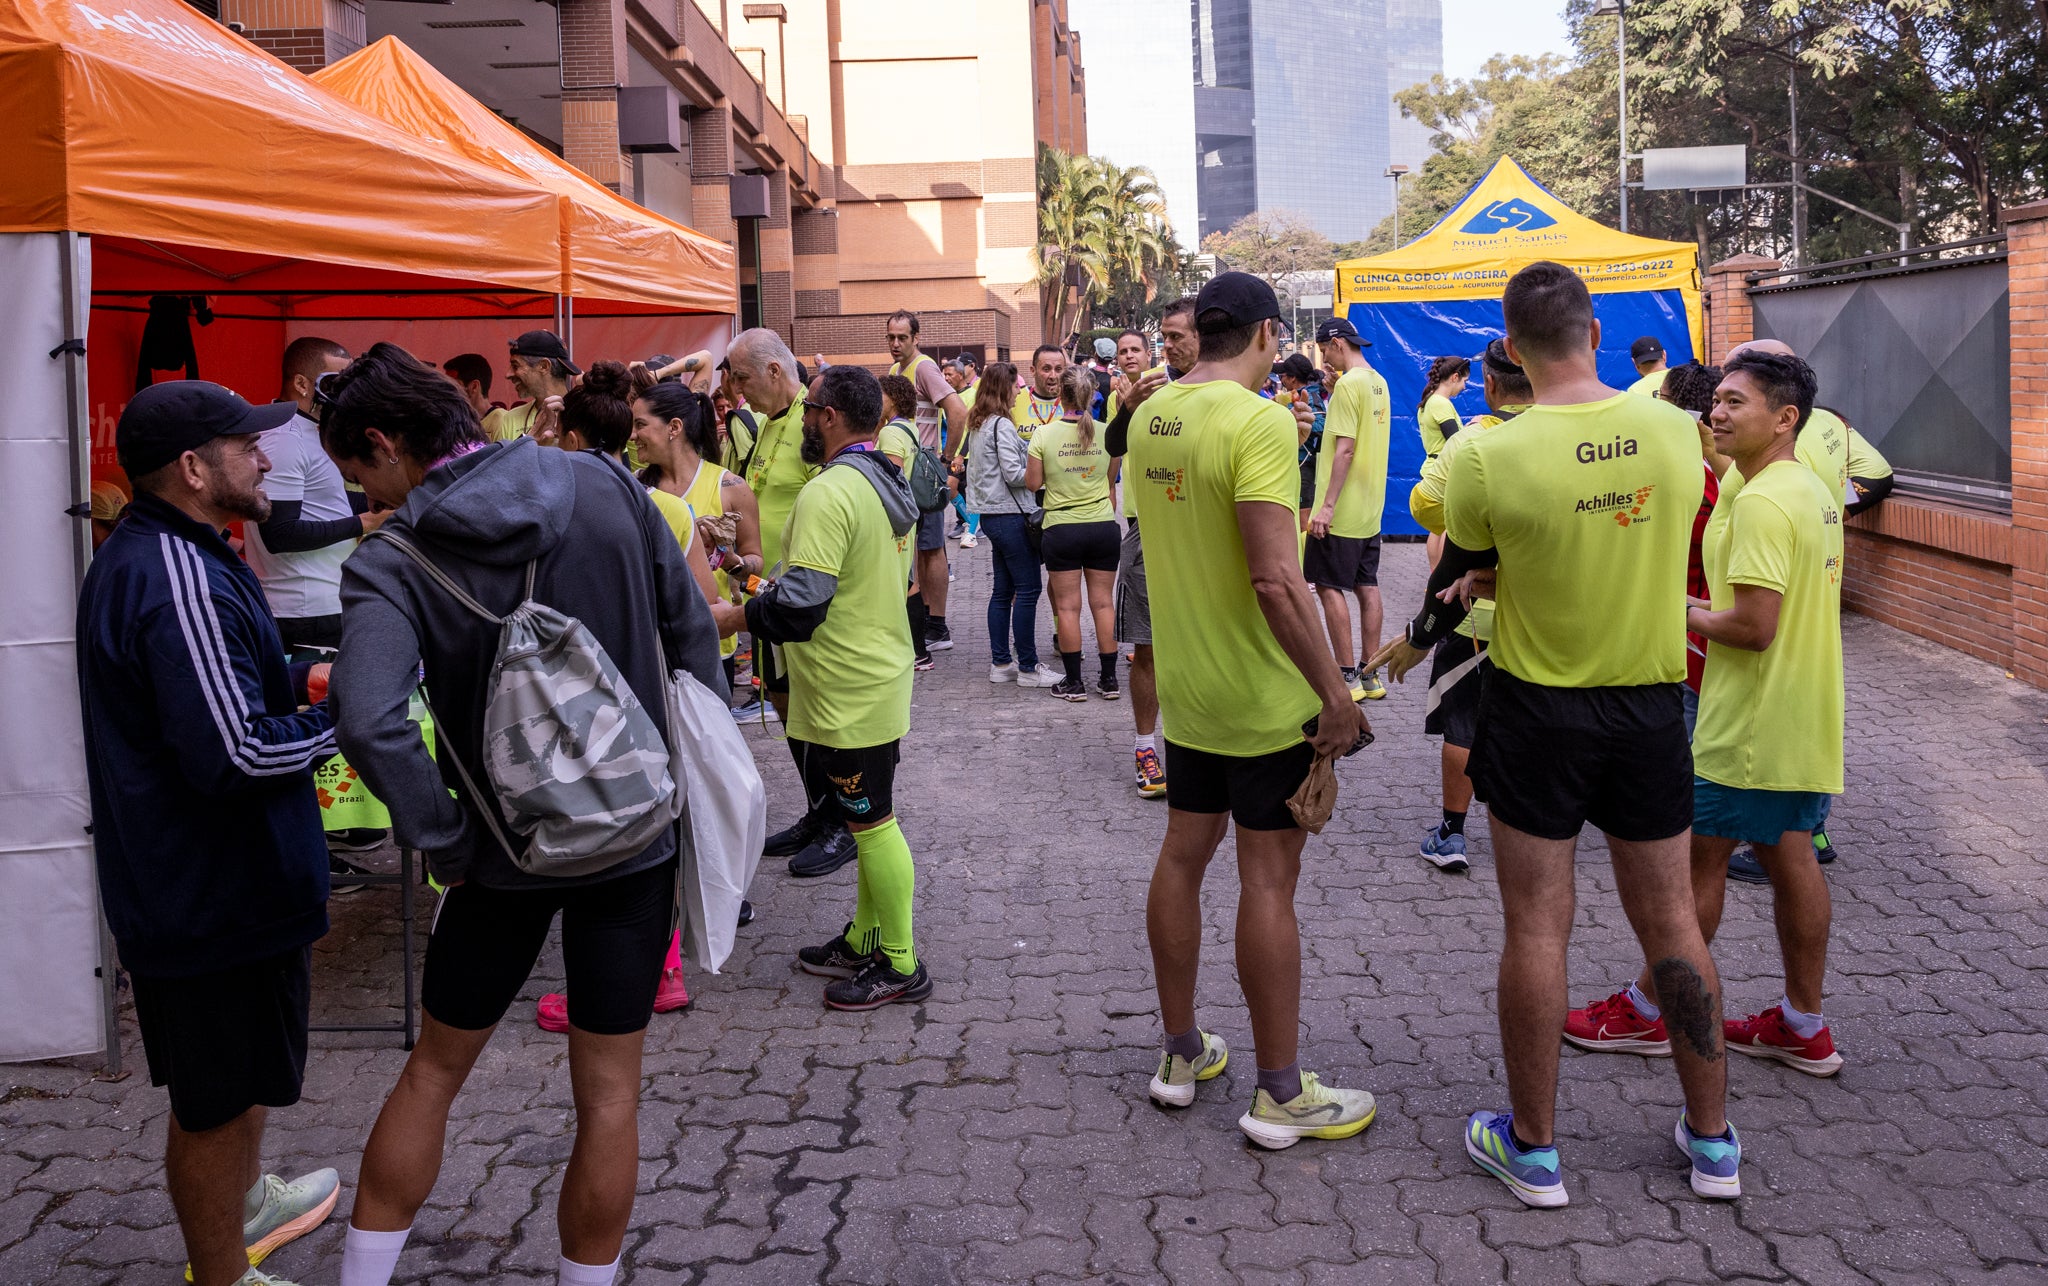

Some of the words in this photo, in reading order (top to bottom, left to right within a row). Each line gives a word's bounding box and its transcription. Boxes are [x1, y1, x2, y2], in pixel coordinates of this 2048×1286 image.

[1453, 237, 1508, 247] Miguel
[1514, 233, 1568, 243] Sarkis
[1605, 260, 1674, 273] 3253-6222
[1354, 272, 1400, 284] CLÍNICA
[1404, 273, 1448, 282] GODOY
[1453, 270, 1508, 280] MOREIRA
[1575, 435, 1638, 464] Guia
[1145, 467, 1176, 481] Achilles
[1575, 491, 1634, 513] Achilles
[1588, 505, 1633, 516] INTERNATIONAL
[1822, 506, 1838, 524] uia
[1632, 516, 1651, 524] Brazil
[339, 795, 365, 804] Brazil
